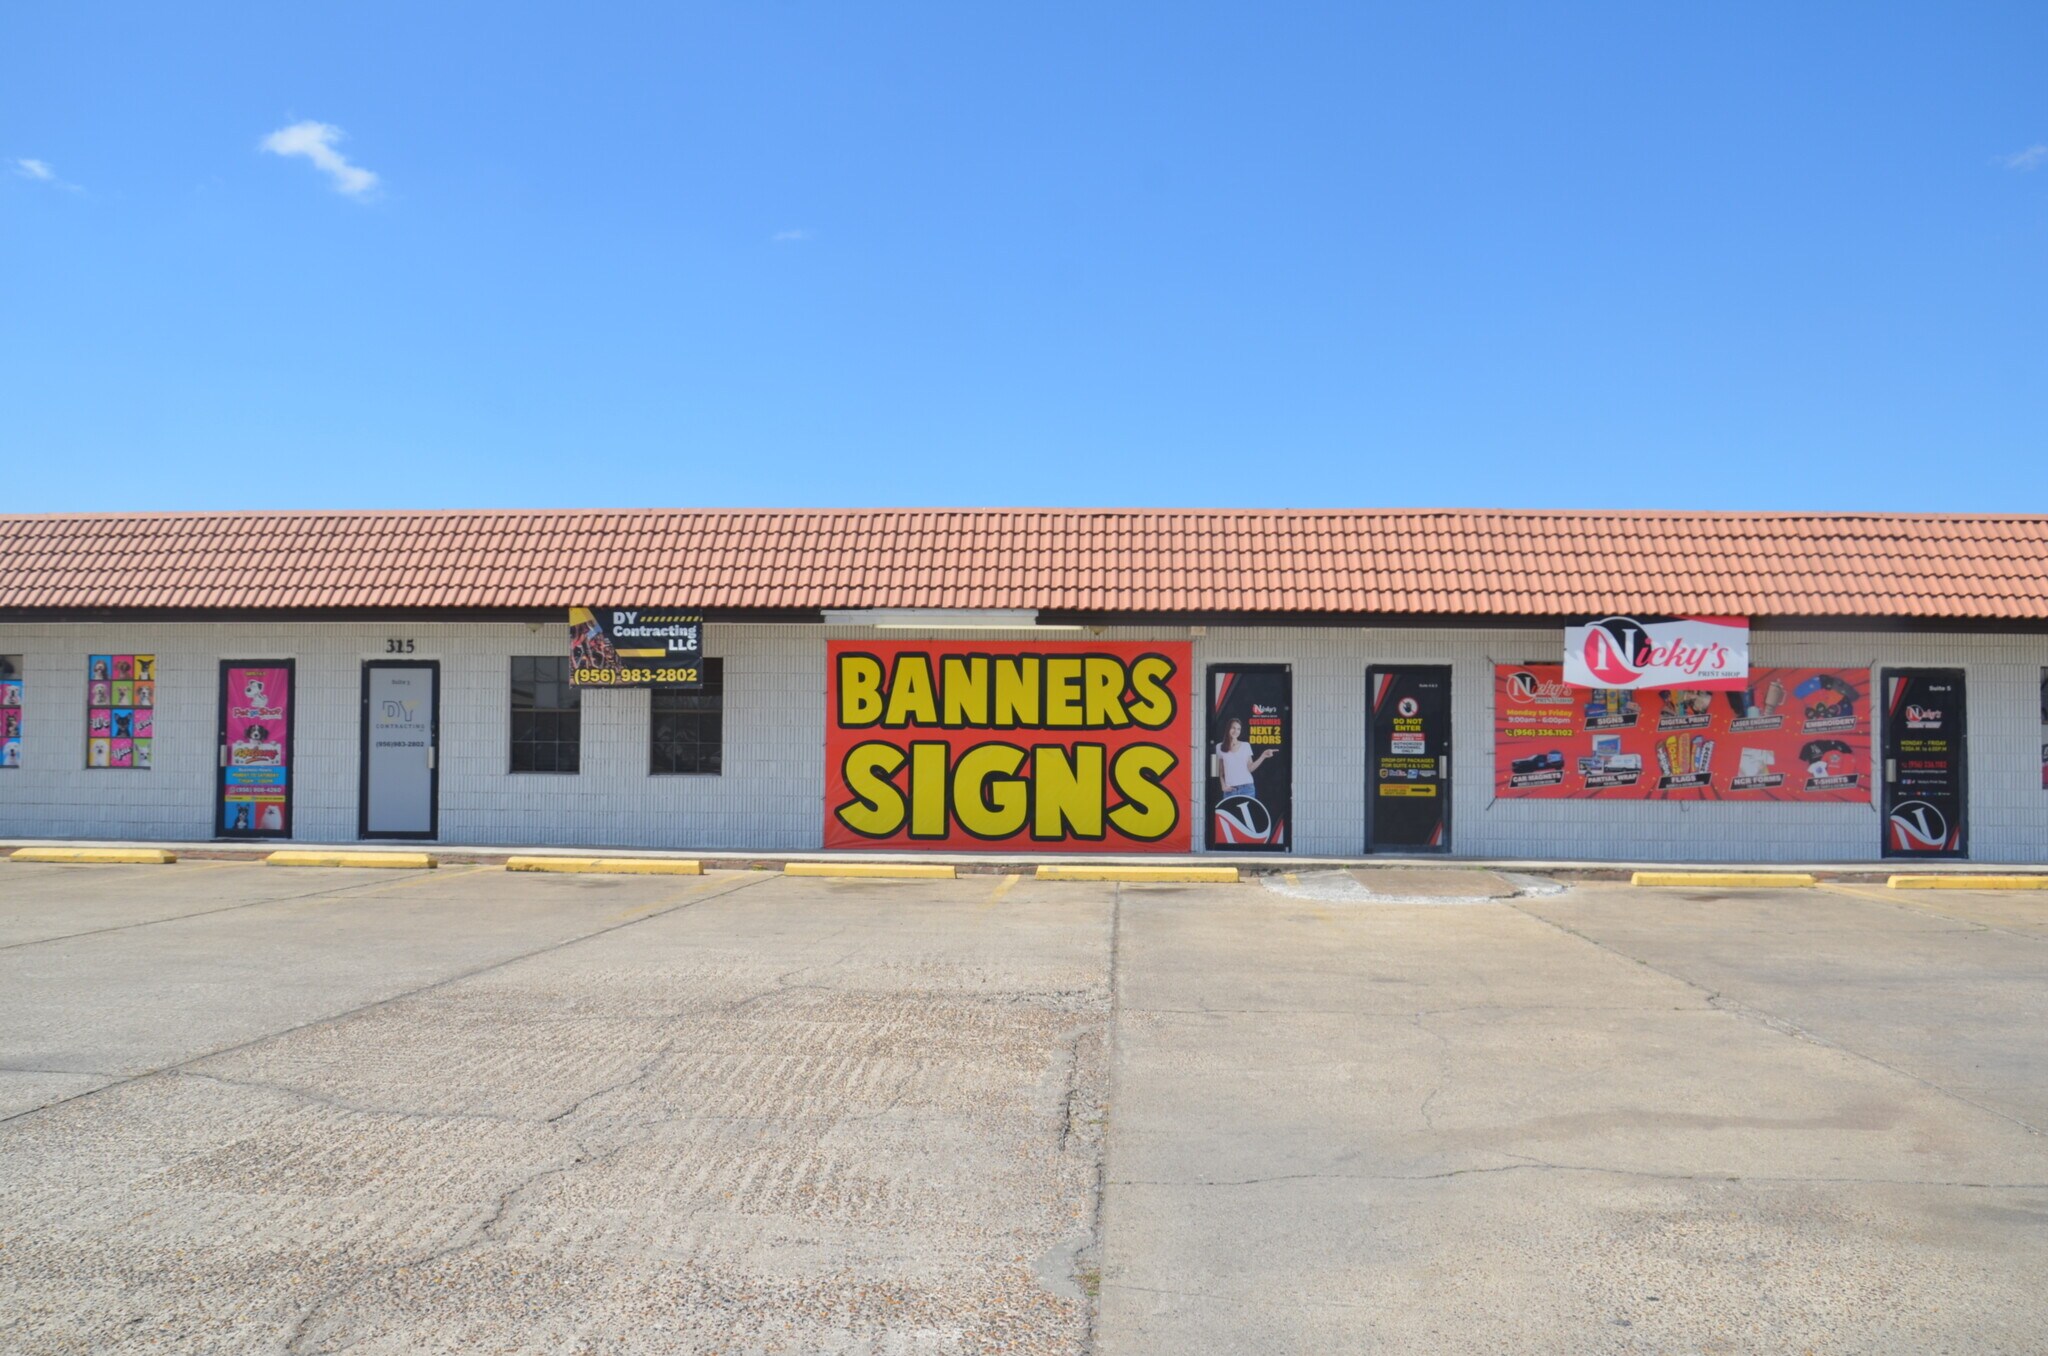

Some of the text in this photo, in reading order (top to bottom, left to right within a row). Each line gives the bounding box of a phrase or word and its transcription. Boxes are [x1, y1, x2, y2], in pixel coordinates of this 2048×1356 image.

[612, 611, 637, 625] DY
[612, 624, 697, 639] Contracting
[386, 638, 415, 654] 315
[668, 639, 698, 651] LLC
[1584, 616, 1729, 685] Nicky's
[574, 668, 698, 685] (956) 983-2802
[1697, 670, 1741, 679] PRINT SHOP
[837, 652, 1178, 731] BANNERS
[1597, 716, 1624, 725] SIGNS
[1660, 717, 1688, 726] DIGITAL
[1805, 717, 1855, 728] EMBROIDERY
[1249, 726, 1281, 735] NEXT 2
[1513, 728, 1536, 737] (956)
[1249, 735, 1282, 745] DOORS
[1528, 772, 1562, 782] MAGNETS
[1671, 775, 1697, 784] FLAGS
[1813, 776, 1849, 785] T-SHIRTS
[834, 740, 1180, 843] SIGNS
